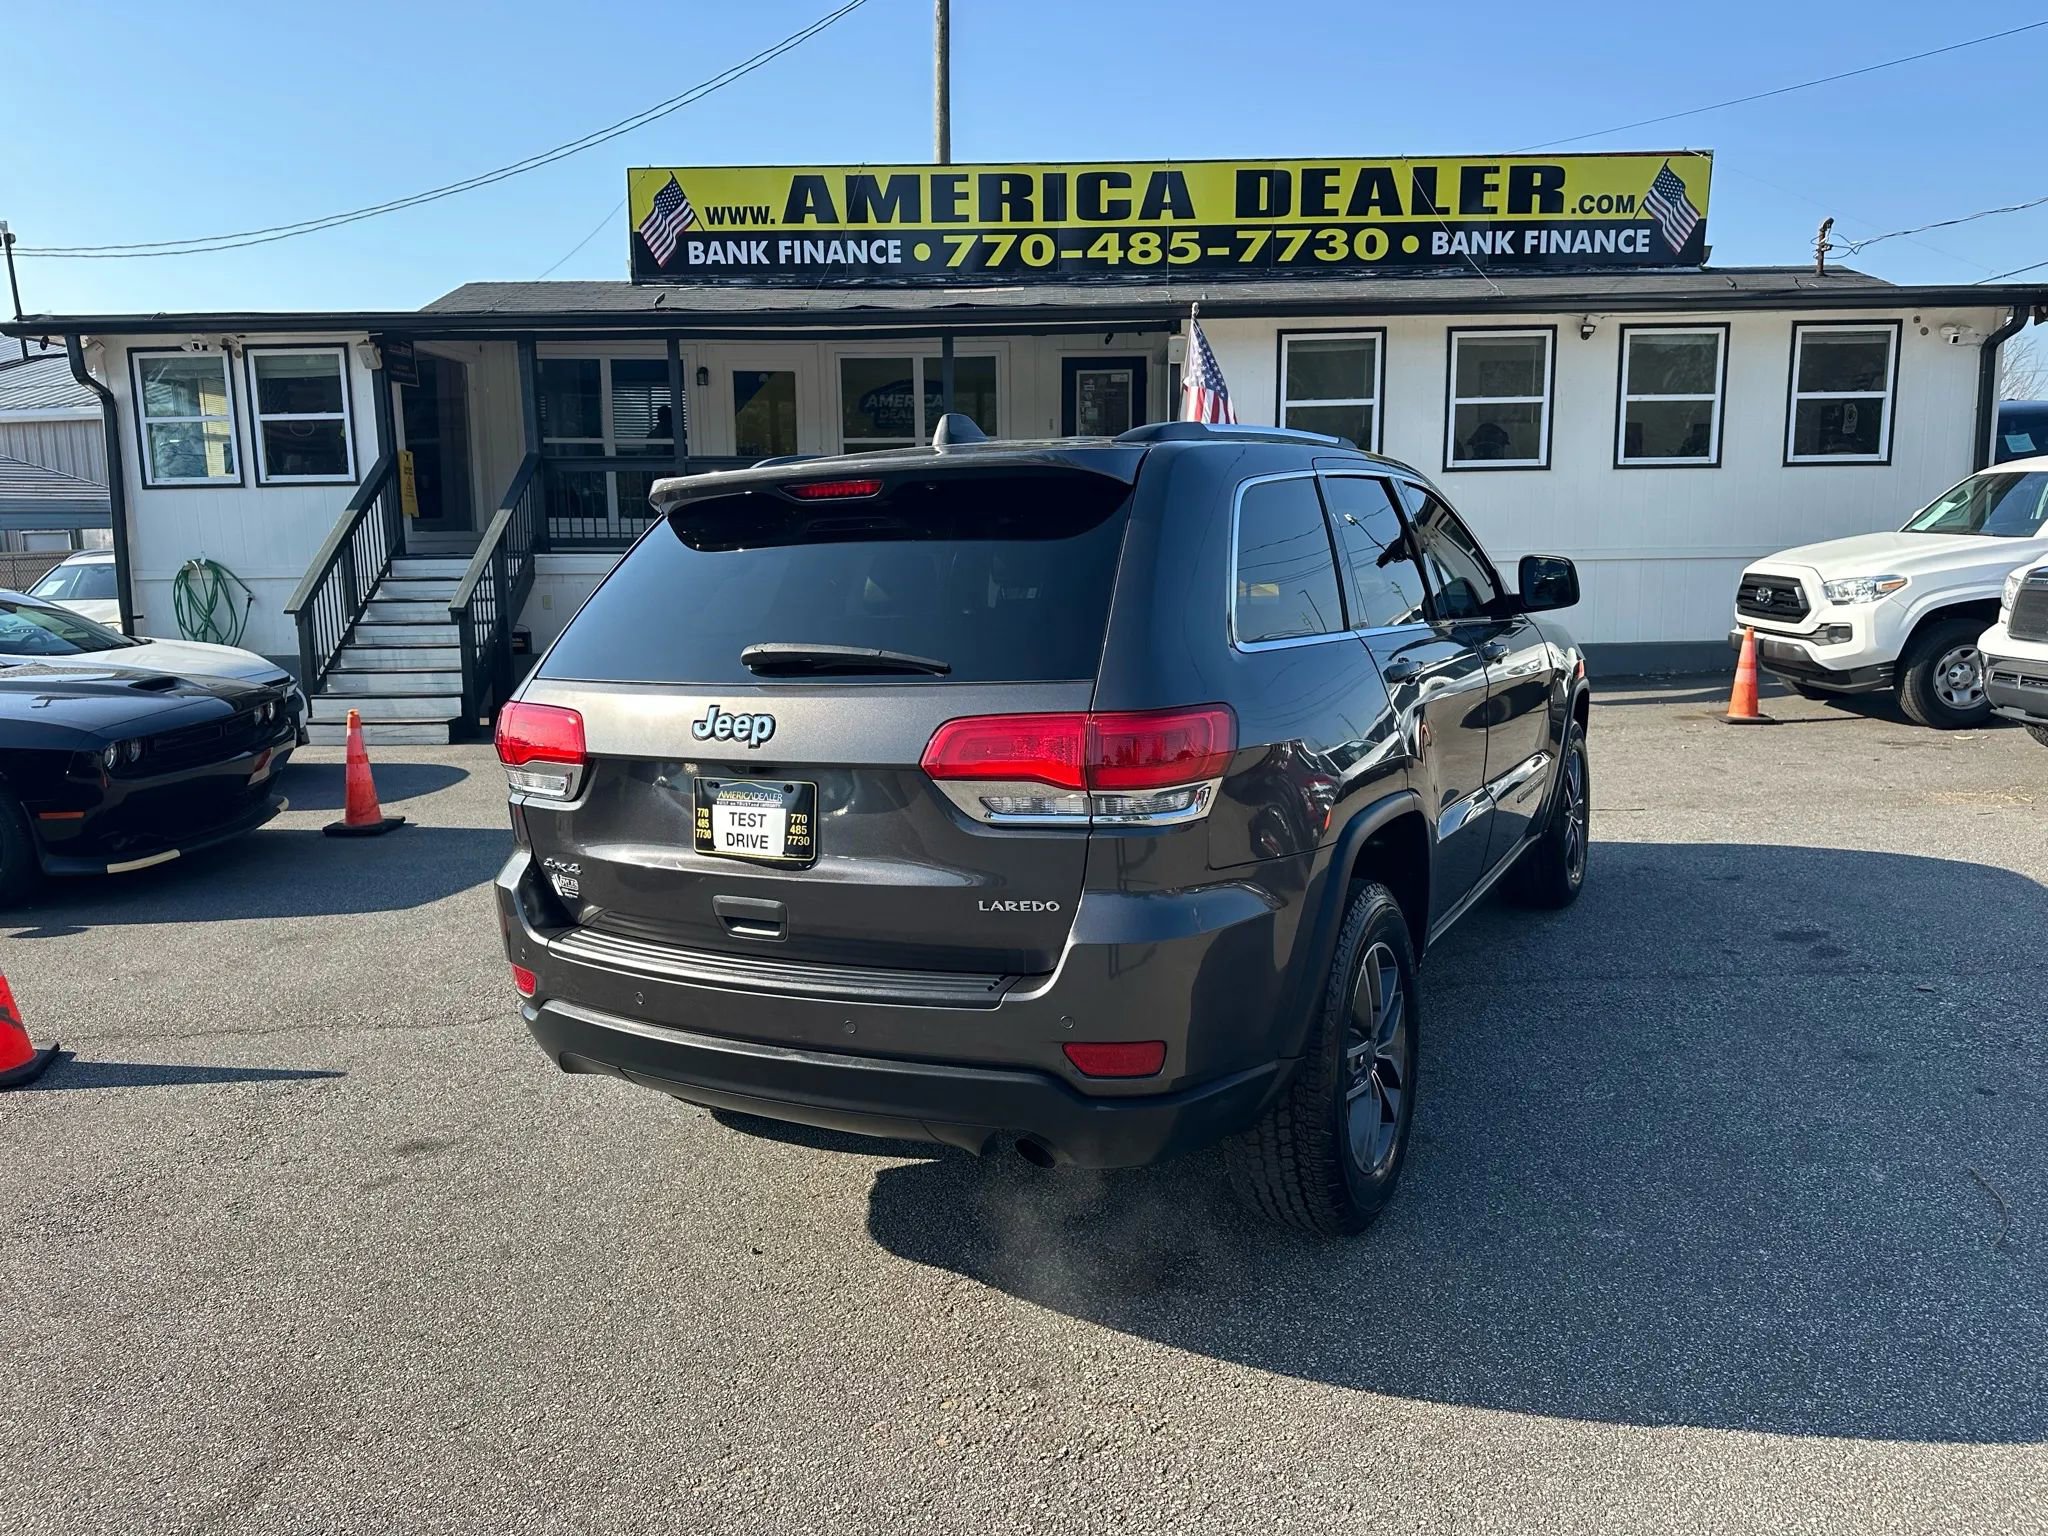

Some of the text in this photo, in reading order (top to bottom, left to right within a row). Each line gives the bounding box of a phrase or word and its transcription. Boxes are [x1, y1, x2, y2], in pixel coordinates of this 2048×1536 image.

[782, 170, 1196, 224] AMERICA
[1235, 164, 1566, 219] DEALER
[687, 228, 1650, 268] BANK FINANCE 770-485-7730 BANK FINANCE
[864, 393, 944, 408] AMERCA
[692, 705, 777, 749] Jeep
[697, 808, 709, 818] 770
[790, 814, 807, 824] 770
[697, 818, 709, 828] 485
[729, 812, 767, 828] TEST
[696, 829, 712, 839] 7730
[789, 825, 807, 835] 485
[726, 833, 769, 849] DRIVE
[787, 836, 810, 846] 7730
[978, 900, 1060, 912] LAREDO
